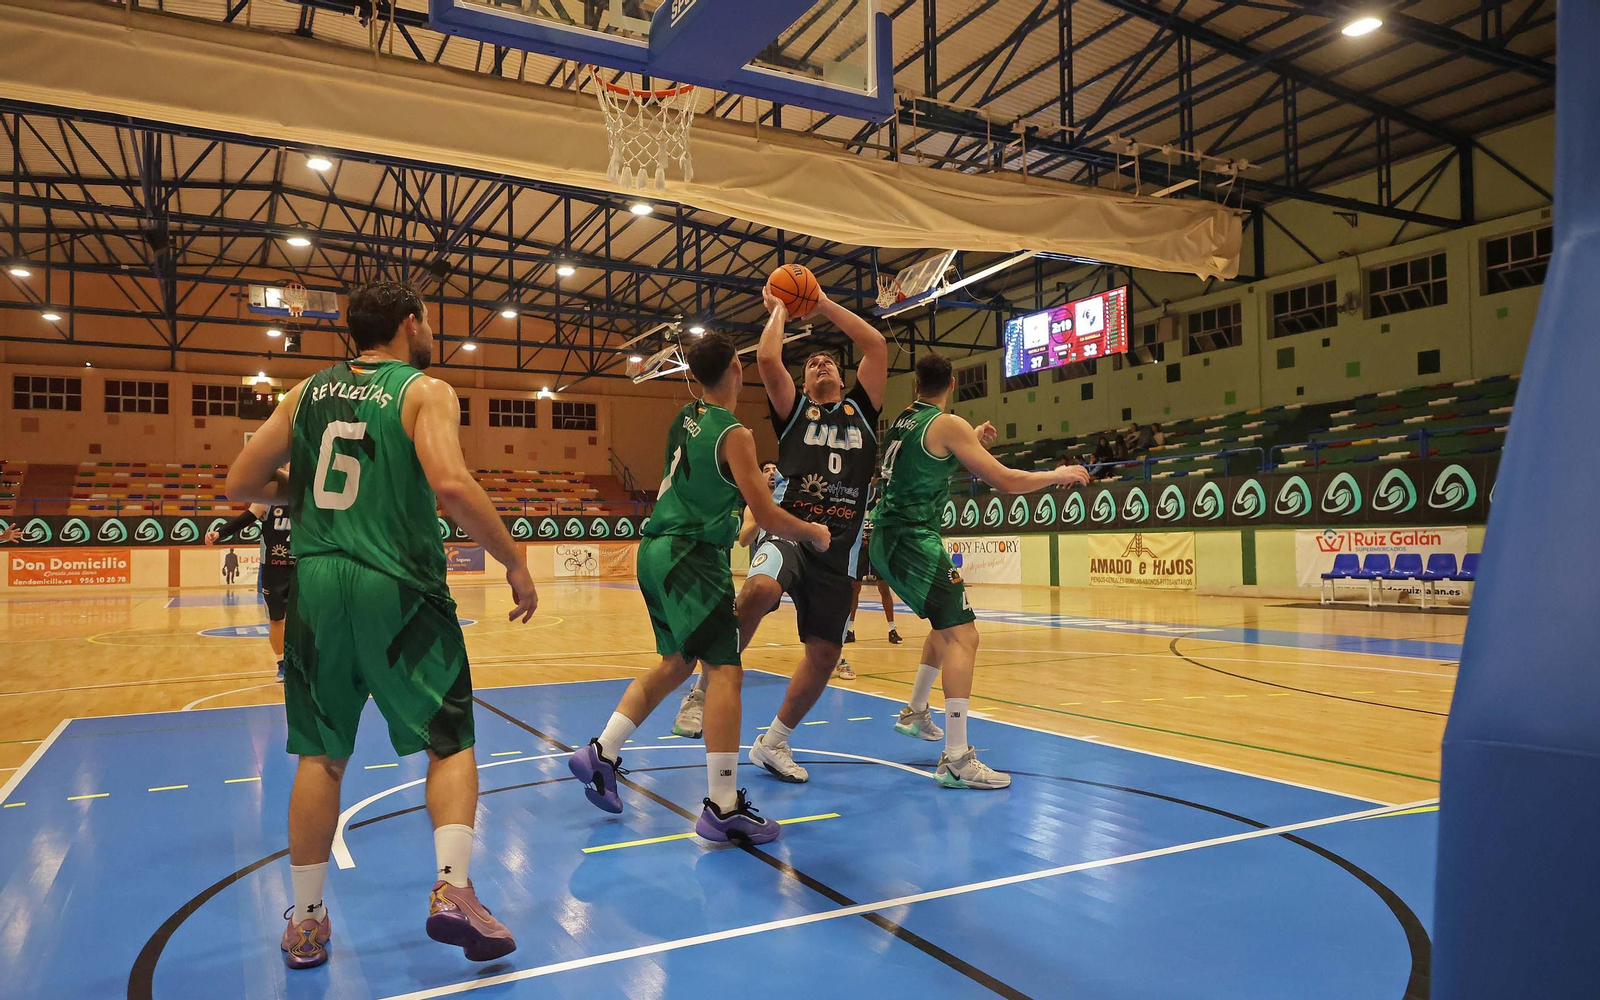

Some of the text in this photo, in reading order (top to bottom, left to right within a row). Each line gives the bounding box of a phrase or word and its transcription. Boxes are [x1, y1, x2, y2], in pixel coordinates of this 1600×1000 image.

[313, 420, 367, 511] 6
[828, 452, 842, 474] 0
[1354, 530, 1441, 546] Ruiz Galán
[948, 540, 1019, 553] BODY FACTORY
[12, 556, 127, 571] Don Domicilio
[1090, 559, 1194, 576] AMADO e HIJOS
